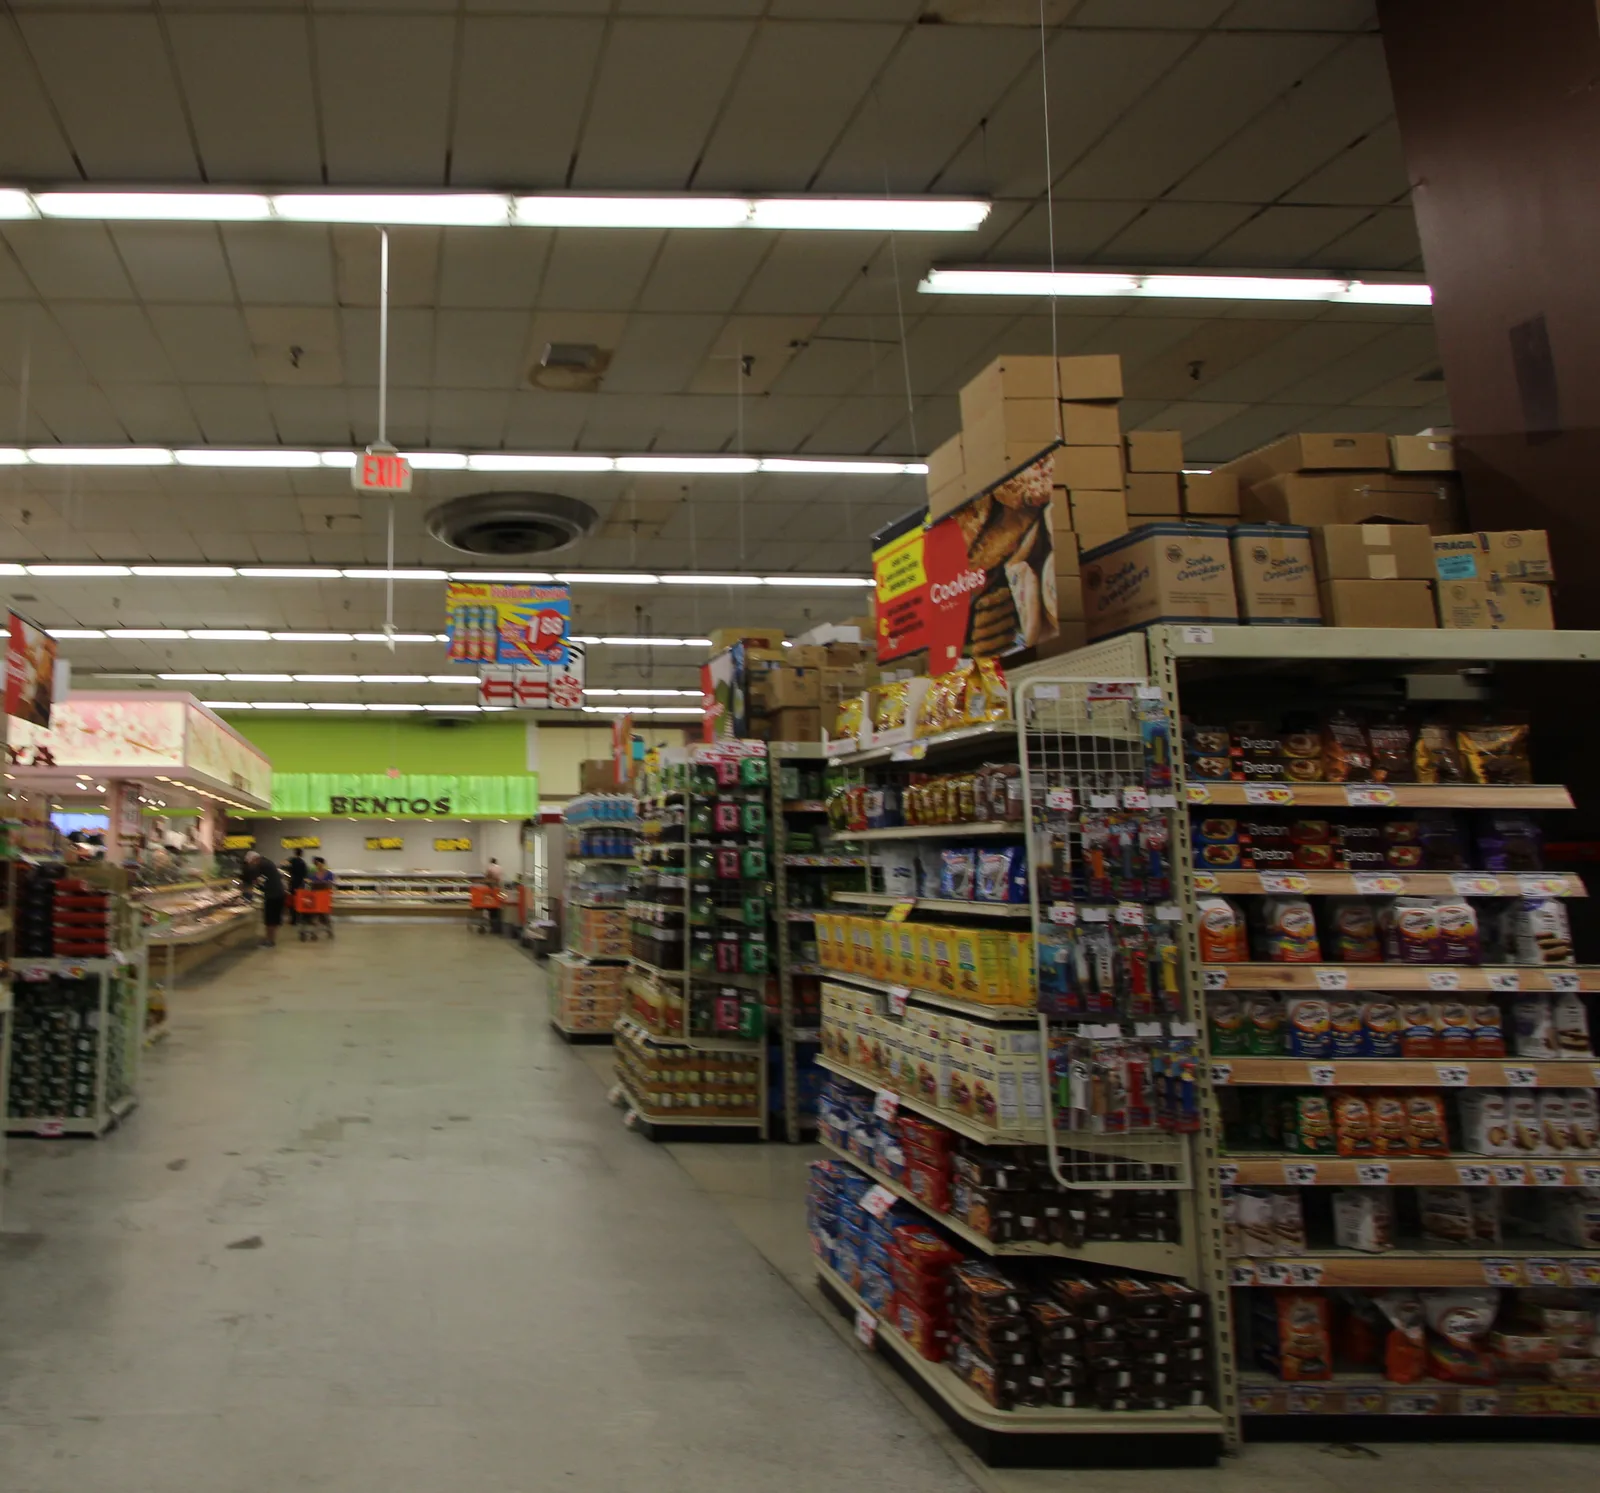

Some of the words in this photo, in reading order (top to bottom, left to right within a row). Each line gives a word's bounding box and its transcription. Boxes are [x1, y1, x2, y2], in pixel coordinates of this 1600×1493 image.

[363, 455, 404, 488] EXIT
[929, 568, 986, 604] Cookies
[1240, 736, 1282, 749] Breton
[1242, 761, 1284, 773] Breton
[330, 796, 450, 815] BENTOS
[1250, 823, 1290, 837] Breton
[1338, 824, 1380, 838] Breton
[1252, 848, 1294, 861] Breton
[1343, 849, 1385, 862] Breton
